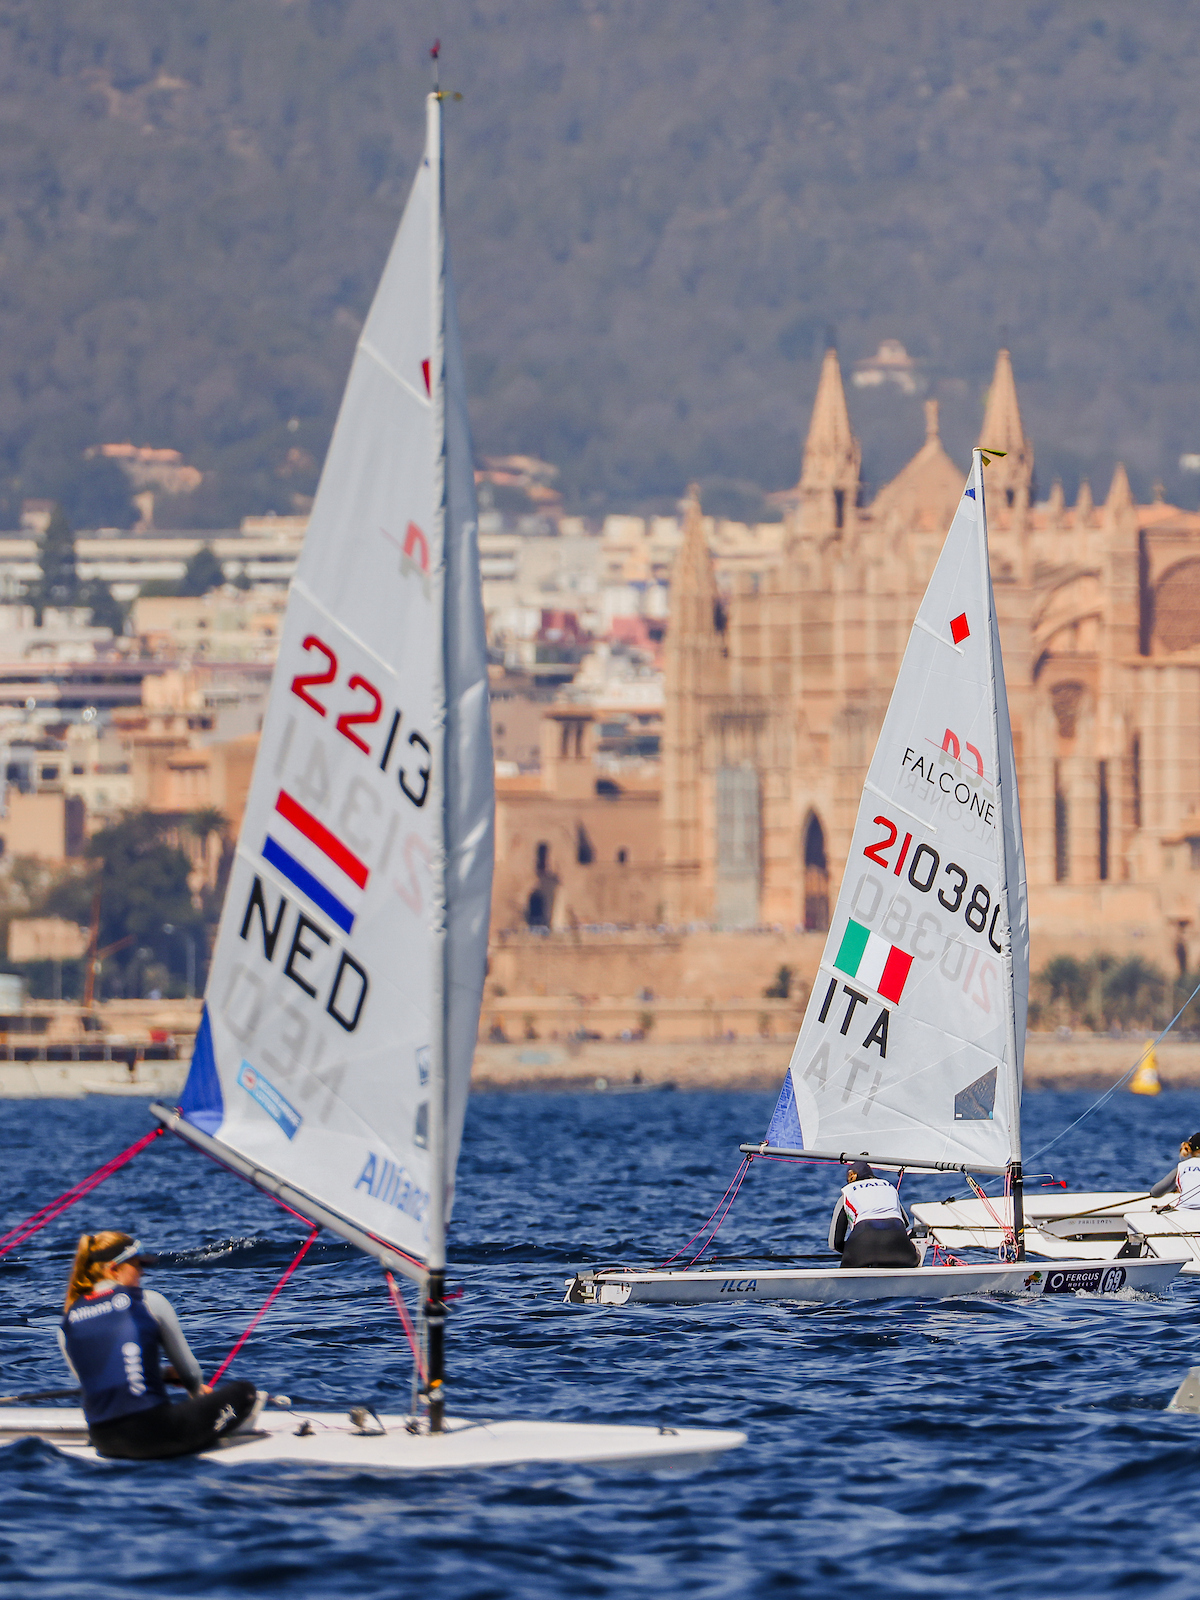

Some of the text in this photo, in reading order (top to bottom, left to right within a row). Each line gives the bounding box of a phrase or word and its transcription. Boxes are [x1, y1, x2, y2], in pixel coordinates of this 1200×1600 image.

[902, 747, 997, 829] FALCONE
[240, 873, 369, 1033] NED
[817, 978, 890, 1059] ITA
[719, 1279, 758, 1293] ILCA
[1065, 1271, 1100, 1282] FERGUS
[1103, 1269, 1123, 1292] 69
